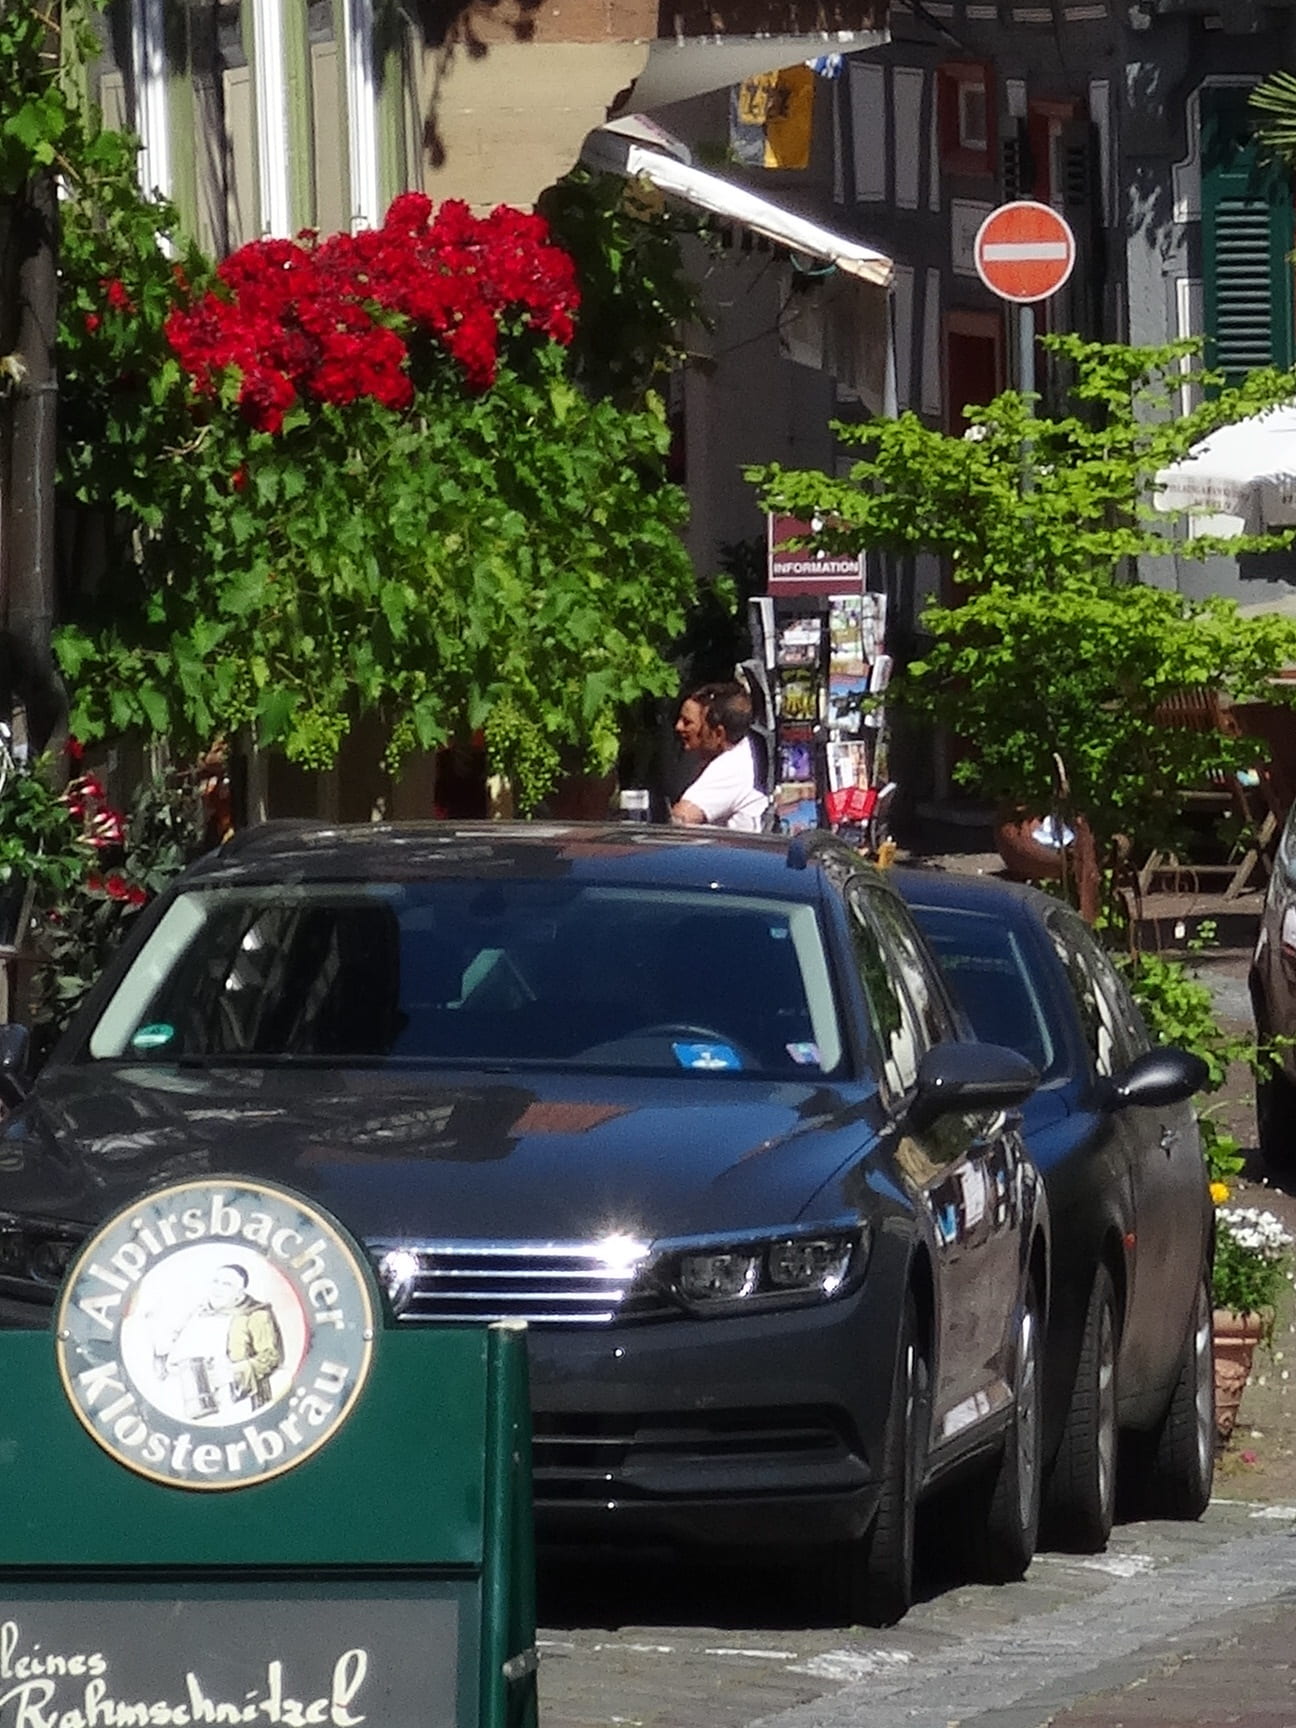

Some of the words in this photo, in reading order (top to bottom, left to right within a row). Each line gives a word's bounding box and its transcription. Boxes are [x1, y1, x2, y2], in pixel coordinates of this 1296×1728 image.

[773, 561, 858, 574] INFORMATION
[80, 1194, 347, 1332] Alpirsbacher
[79, 1358, 349, 1475] Klosterbräu
